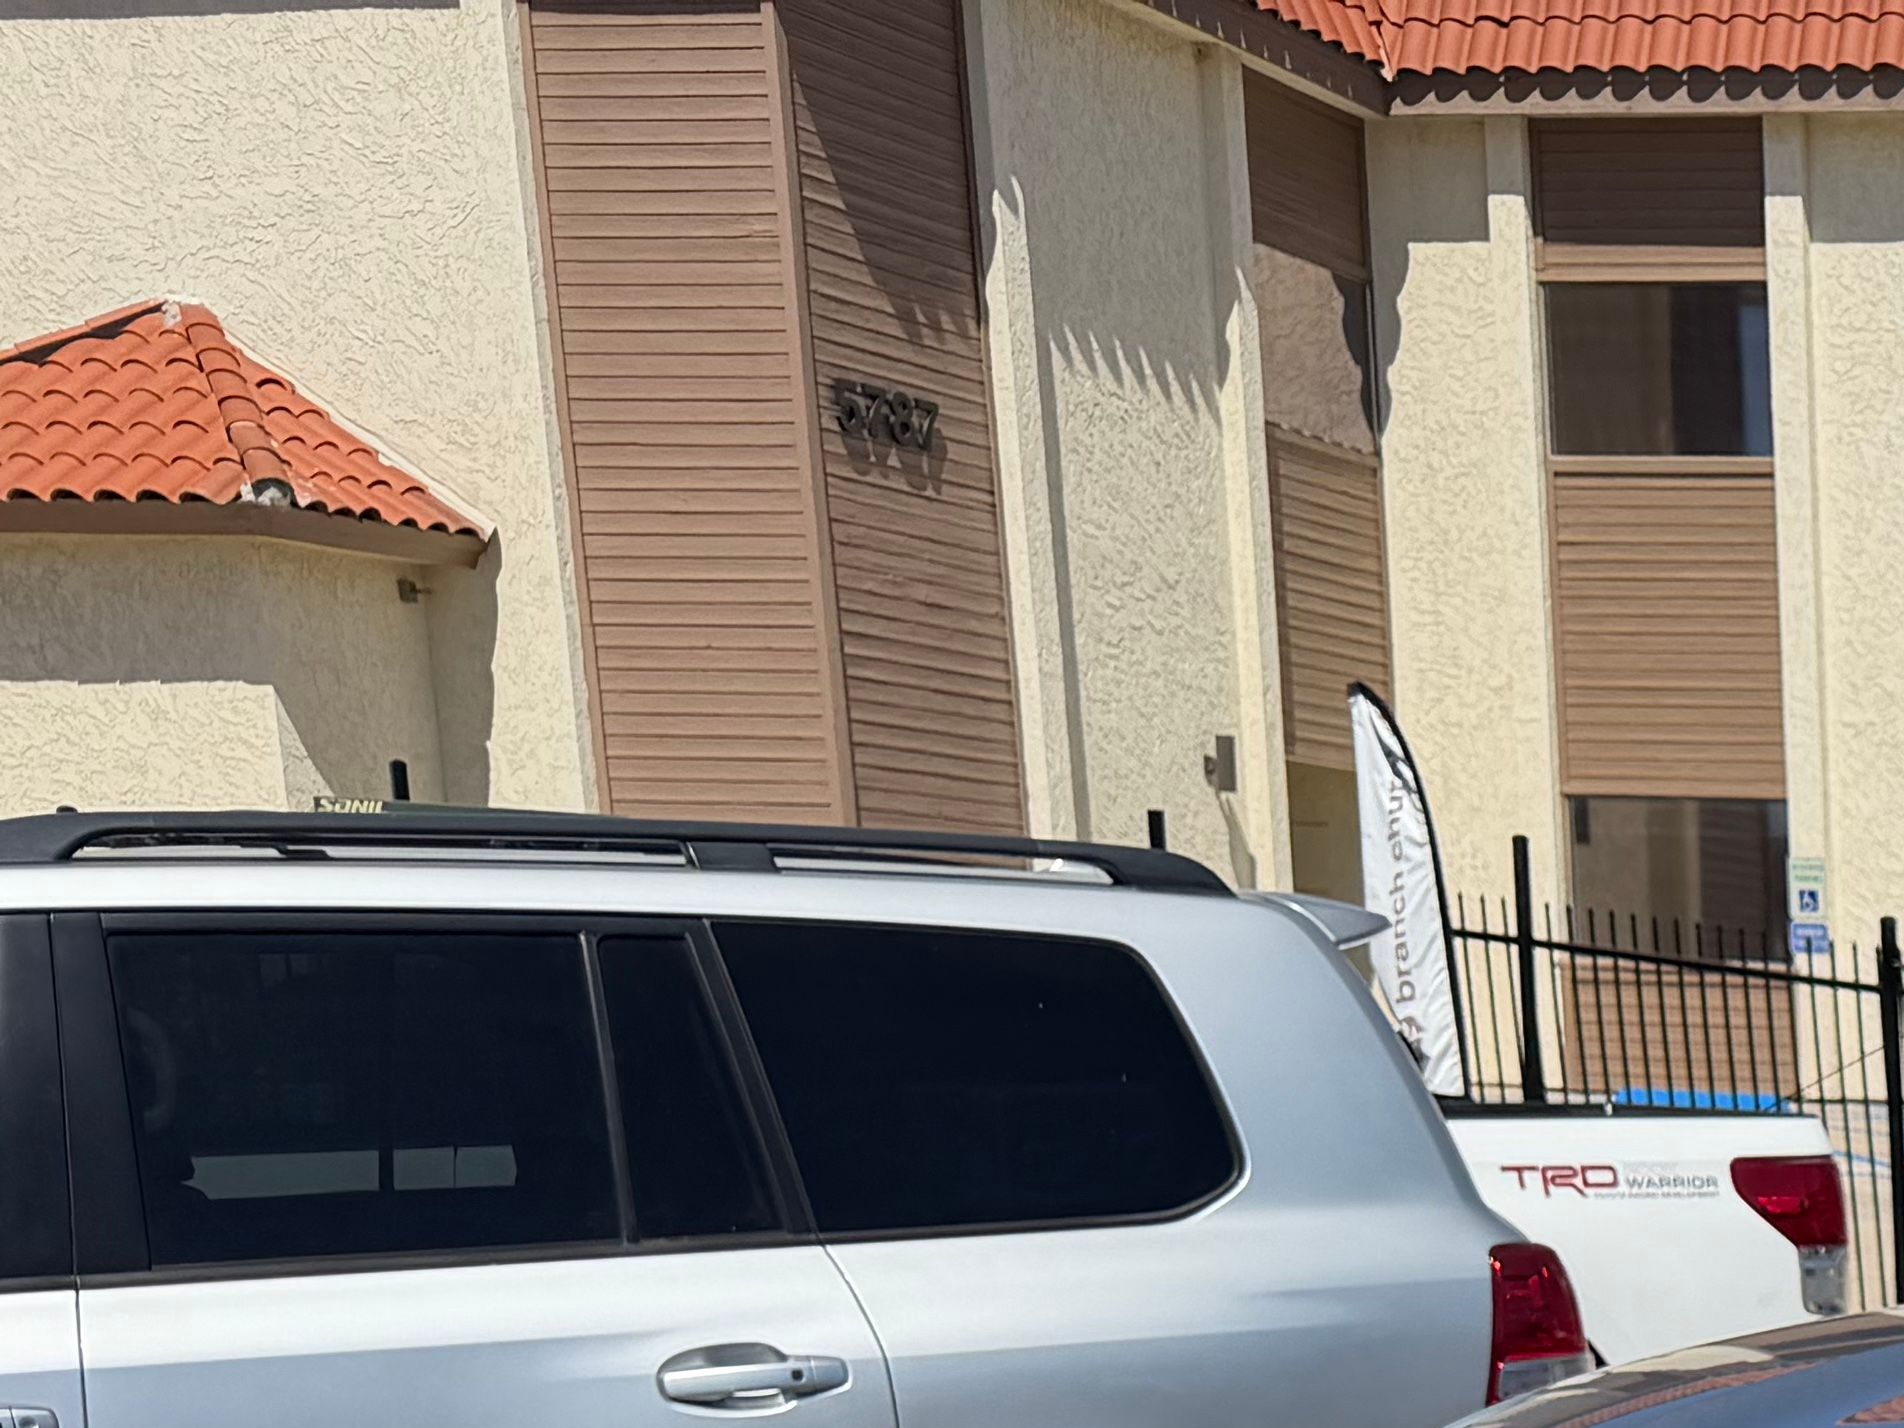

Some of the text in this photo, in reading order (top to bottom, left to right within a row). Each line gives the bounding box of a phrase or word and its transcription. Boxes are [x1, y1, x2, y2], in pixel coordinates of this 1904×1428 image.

[832, 378, 940, 452] 5787
[1388, 871, 1416, 1004] branch
[1501, 1165, 1619, 1198] TRD
[1626, 1175, 1719, 1190] WARRIOR
